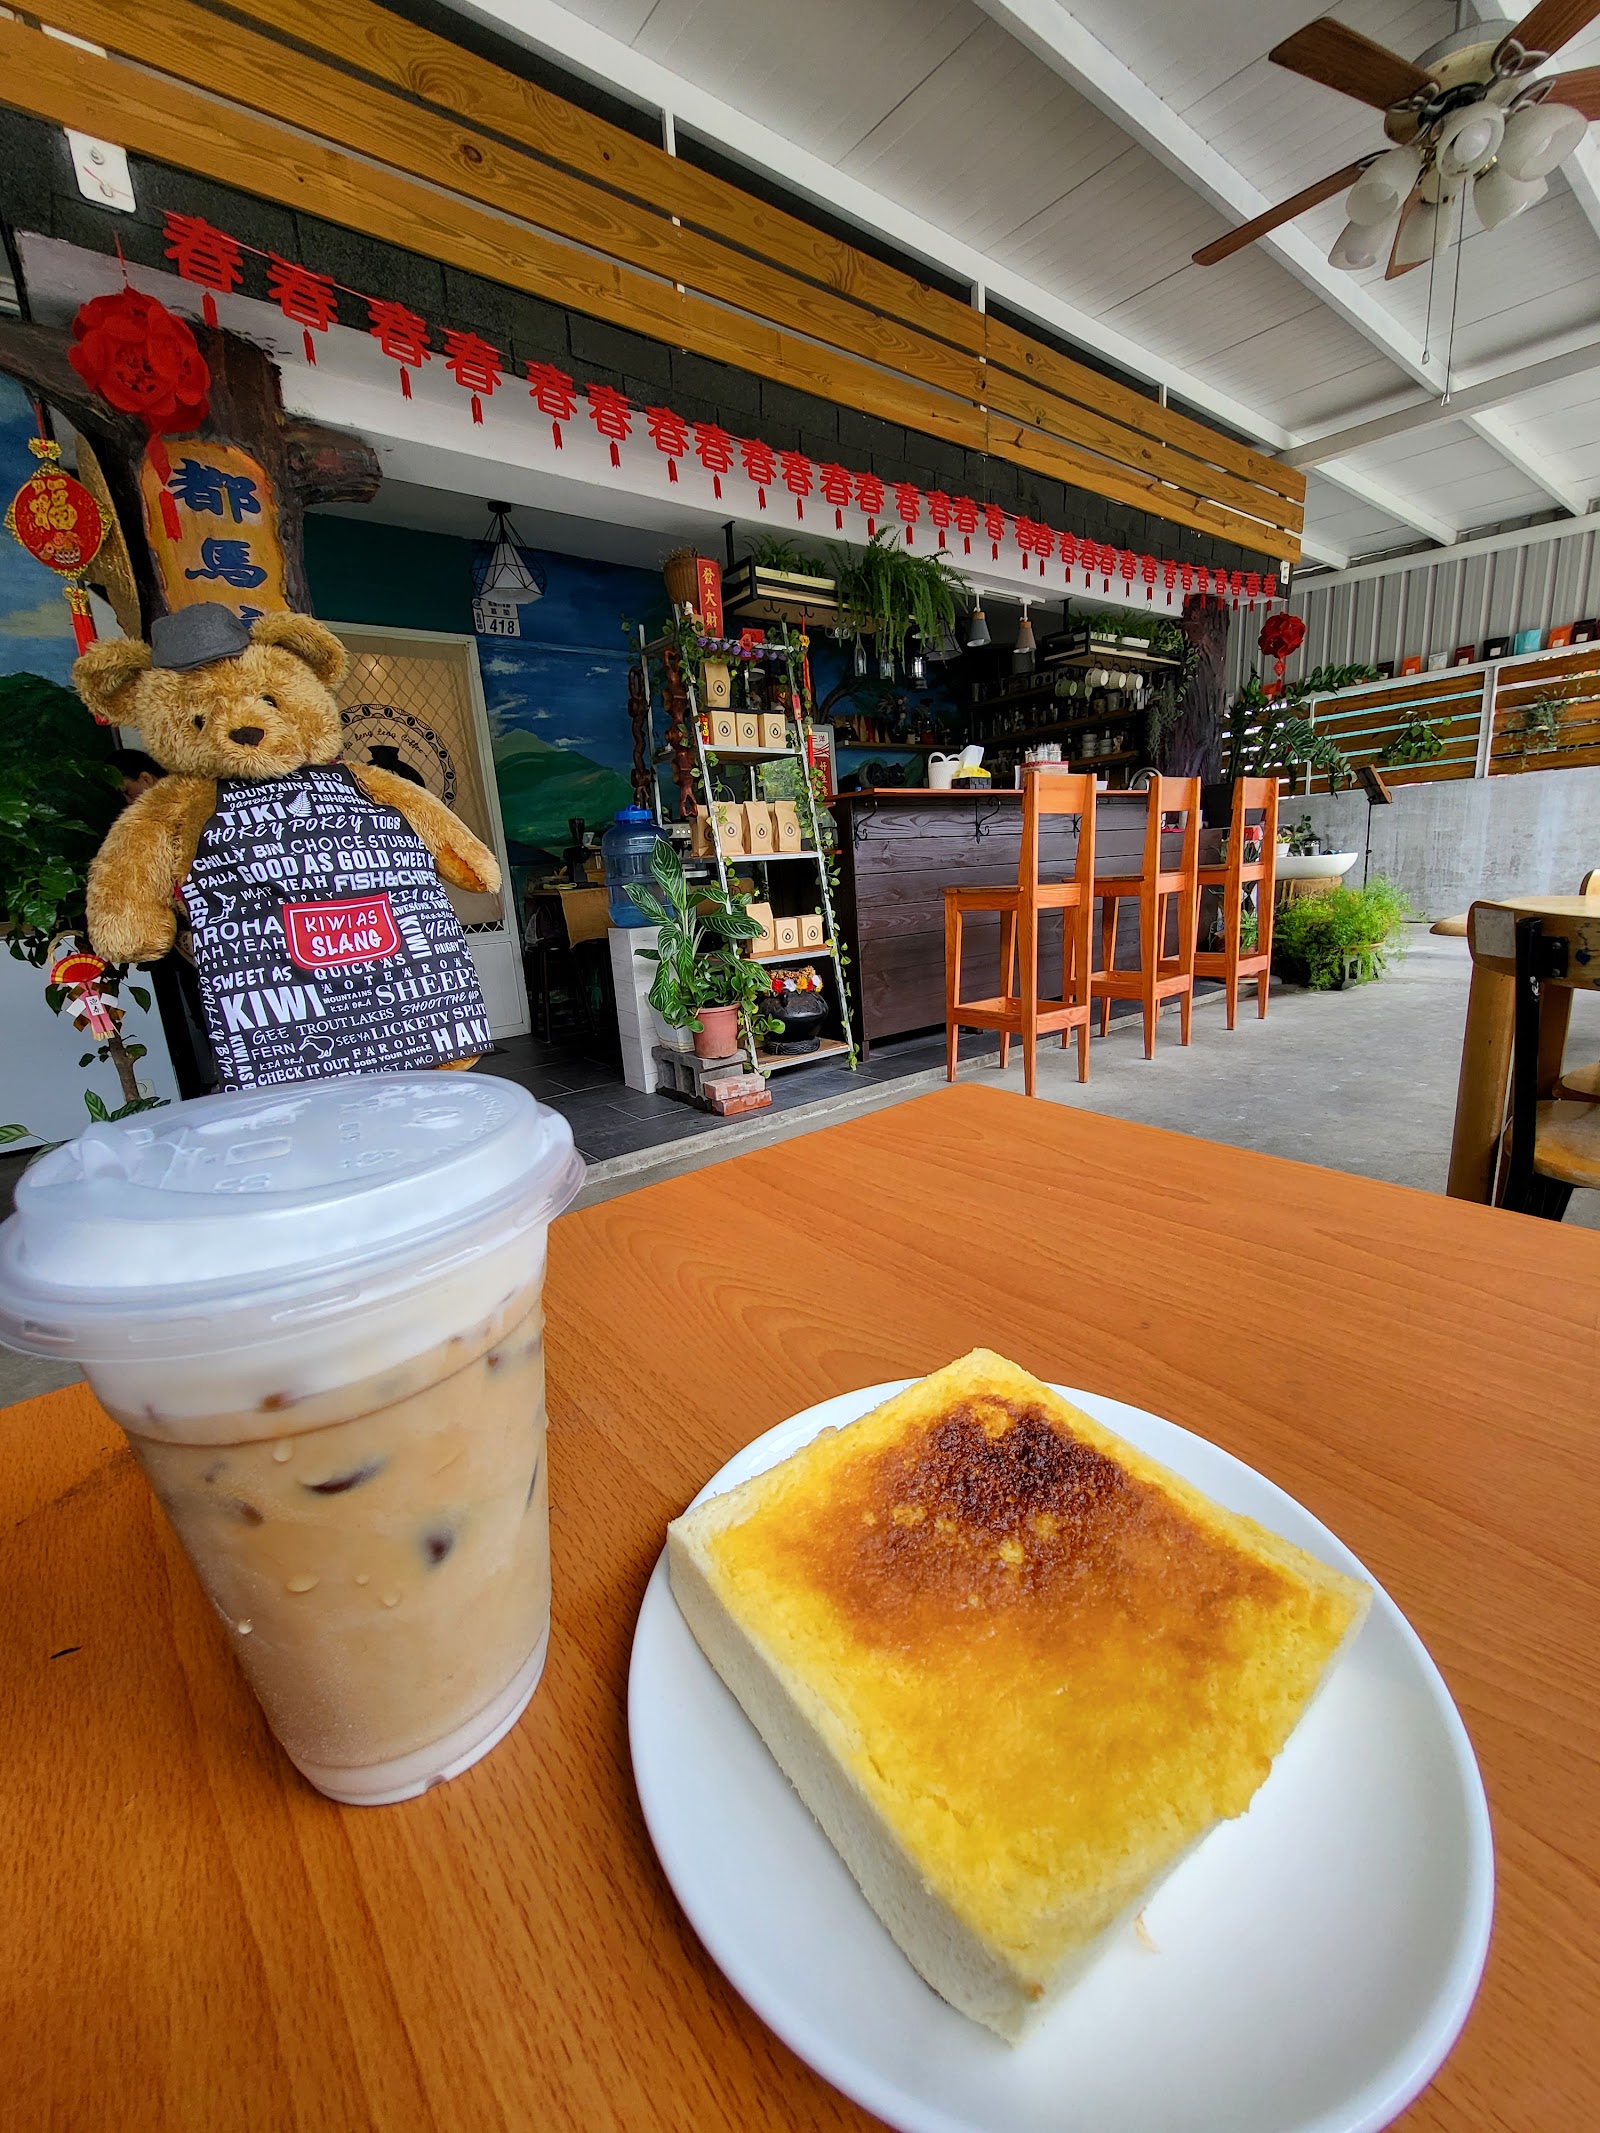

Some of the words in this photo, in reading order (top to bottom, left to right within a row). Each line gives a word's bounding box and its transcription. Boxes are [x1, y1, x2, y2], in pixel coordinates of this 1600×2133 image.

[163, 212, 243, 293] 春
[266, 252, 338, 332] 春
[368, 298, 431, 368] 春
[443, 330, 502, 394] 春
[525, 360, 578, 420] 春
[586, 382, 632, 440] 春
[645, 406, 690, 457] 春
[693, 422, 733, 473] 春
[739, 438, 777, 484] 春
[779, 450, 814, 496] 春
[819, 462, 853, 506] 春
[853, 472, 885, 514] 春
[895, 483, 921, 523] 春
[926, 489, 952, 527] 春
[953, 496, 979, 533] 春
[984, 503, 1006, 540] 春
[1014, 516, 1035, 550] 春
[1033, 523, 1056, 557] 春
[1059, 532, 1078, 565] 春
[1079, 538, 1098, 570] 春
[1098, 544, 1117, 575] 春
[1120, 549, 1137, 580] 春
[1141, 554, 1158, 584] 春
[1163, 560, 1177, 589] 春
[1179, 563, 1194, 590] 春
[1197, 566, 1210, 592] 春
[1213, 568, 1228, 595] 春
[1230, 570, 1243, 597] 春
[1245, 572, 1261, 597] 春
[1263, 573, 1277, 597] 春
[702, 566, 718, 628] 發大財
[489, 618, 515, 635] 418
[309, 771, 343, 782] BRO
[222, 781, 314, 803] MOUNTAINS
[216, 801, 288, 826] TIKI
[314, 804, 346, 815] NAH
[203, 822, 285, 847] HOKEY
[288, 814, 363, 834] POKEY
[290, 836, 366, 854] CHOICE
[192, 847, 246, 872] CHILLY
[252, 842, 285, 859] BIN
[236, 856, 299, 885] GOOD
[303, 851, 334, 875] AS
[337, 849, 391, 871] GOLD
[392, 851, 428, 868] SWEET
[198, 870, 239, 889] PAUA
[275, 874, 329, 892] YEAH
[240, 886, 272, 901] MAP
[241, 890, 335, 915] FRIENDLY
[388, 888, 419, 904] KIA
[304, 914, 352, 932] KIWI
[355, 909, 379, 926] AS
[425, 919, 460, 939] YEAH
[192, 915, 285, 952] AROHA
[311, 928, 383, 957] SLANG
[396, 914, 433, 960] KIWI
[194, 944, 225, 966] NAH
[228, 936, 288, 954] YEAH
[434, 941, 460, 955] RUGBY
[211, 967, 265, 993] SWEET
[271, 965, 293, 982] AS
[313, 960, 377, 981] QUICK
[322, 989, 373, 1004] MOUNTAINS
[375, 968, 471, 1006] SHEEP
[219, 983, 327, 1034] KIWI
[329, 1004, 350, 1013] KIA
[352, 998, 372, 1009] ORA
[400, 996, 444, 1017] SHOOT
[443, 991, 467, 1005] THE
[295, 1018, 348, 1037] TROUT
[348, 1007, 395, 1027] LAKES
[369, 1010, 452, 1041] LICKETY
[452, 1002, 487, 1021] SPLIT
[252, 1026, 291, 1046] GEE
[335, 1035, 358, 1047] SEE
[357, 1031, 371, 1042] YA
[352, 1042, 389, 1060] FAR
[393, 1032, 429, 1050] OUT
[228, 1033, 251, 1064] KIWI
[250, 1042, 297, 1062] FERN
[353, 1058, 378, 1070] BOBS
[378, 1051, 403, 1063] YOUR
[403, 1043, 433, 1057] UNCLE
[459, 1049, 466, 1057] A
[236, 1065, 256, 1082] AS
[257, 1066, 305, 1087] CHECK
[305, 1062, 322, 1077] IT
[323, 1056, 351, 1073] OUT
[259, 1058, 281, 1071] KIA
[283, 1055, 305, 1065] ORA
[403, 1059, 414, 1071] A
[413, 1054, 434, 1067] MO
